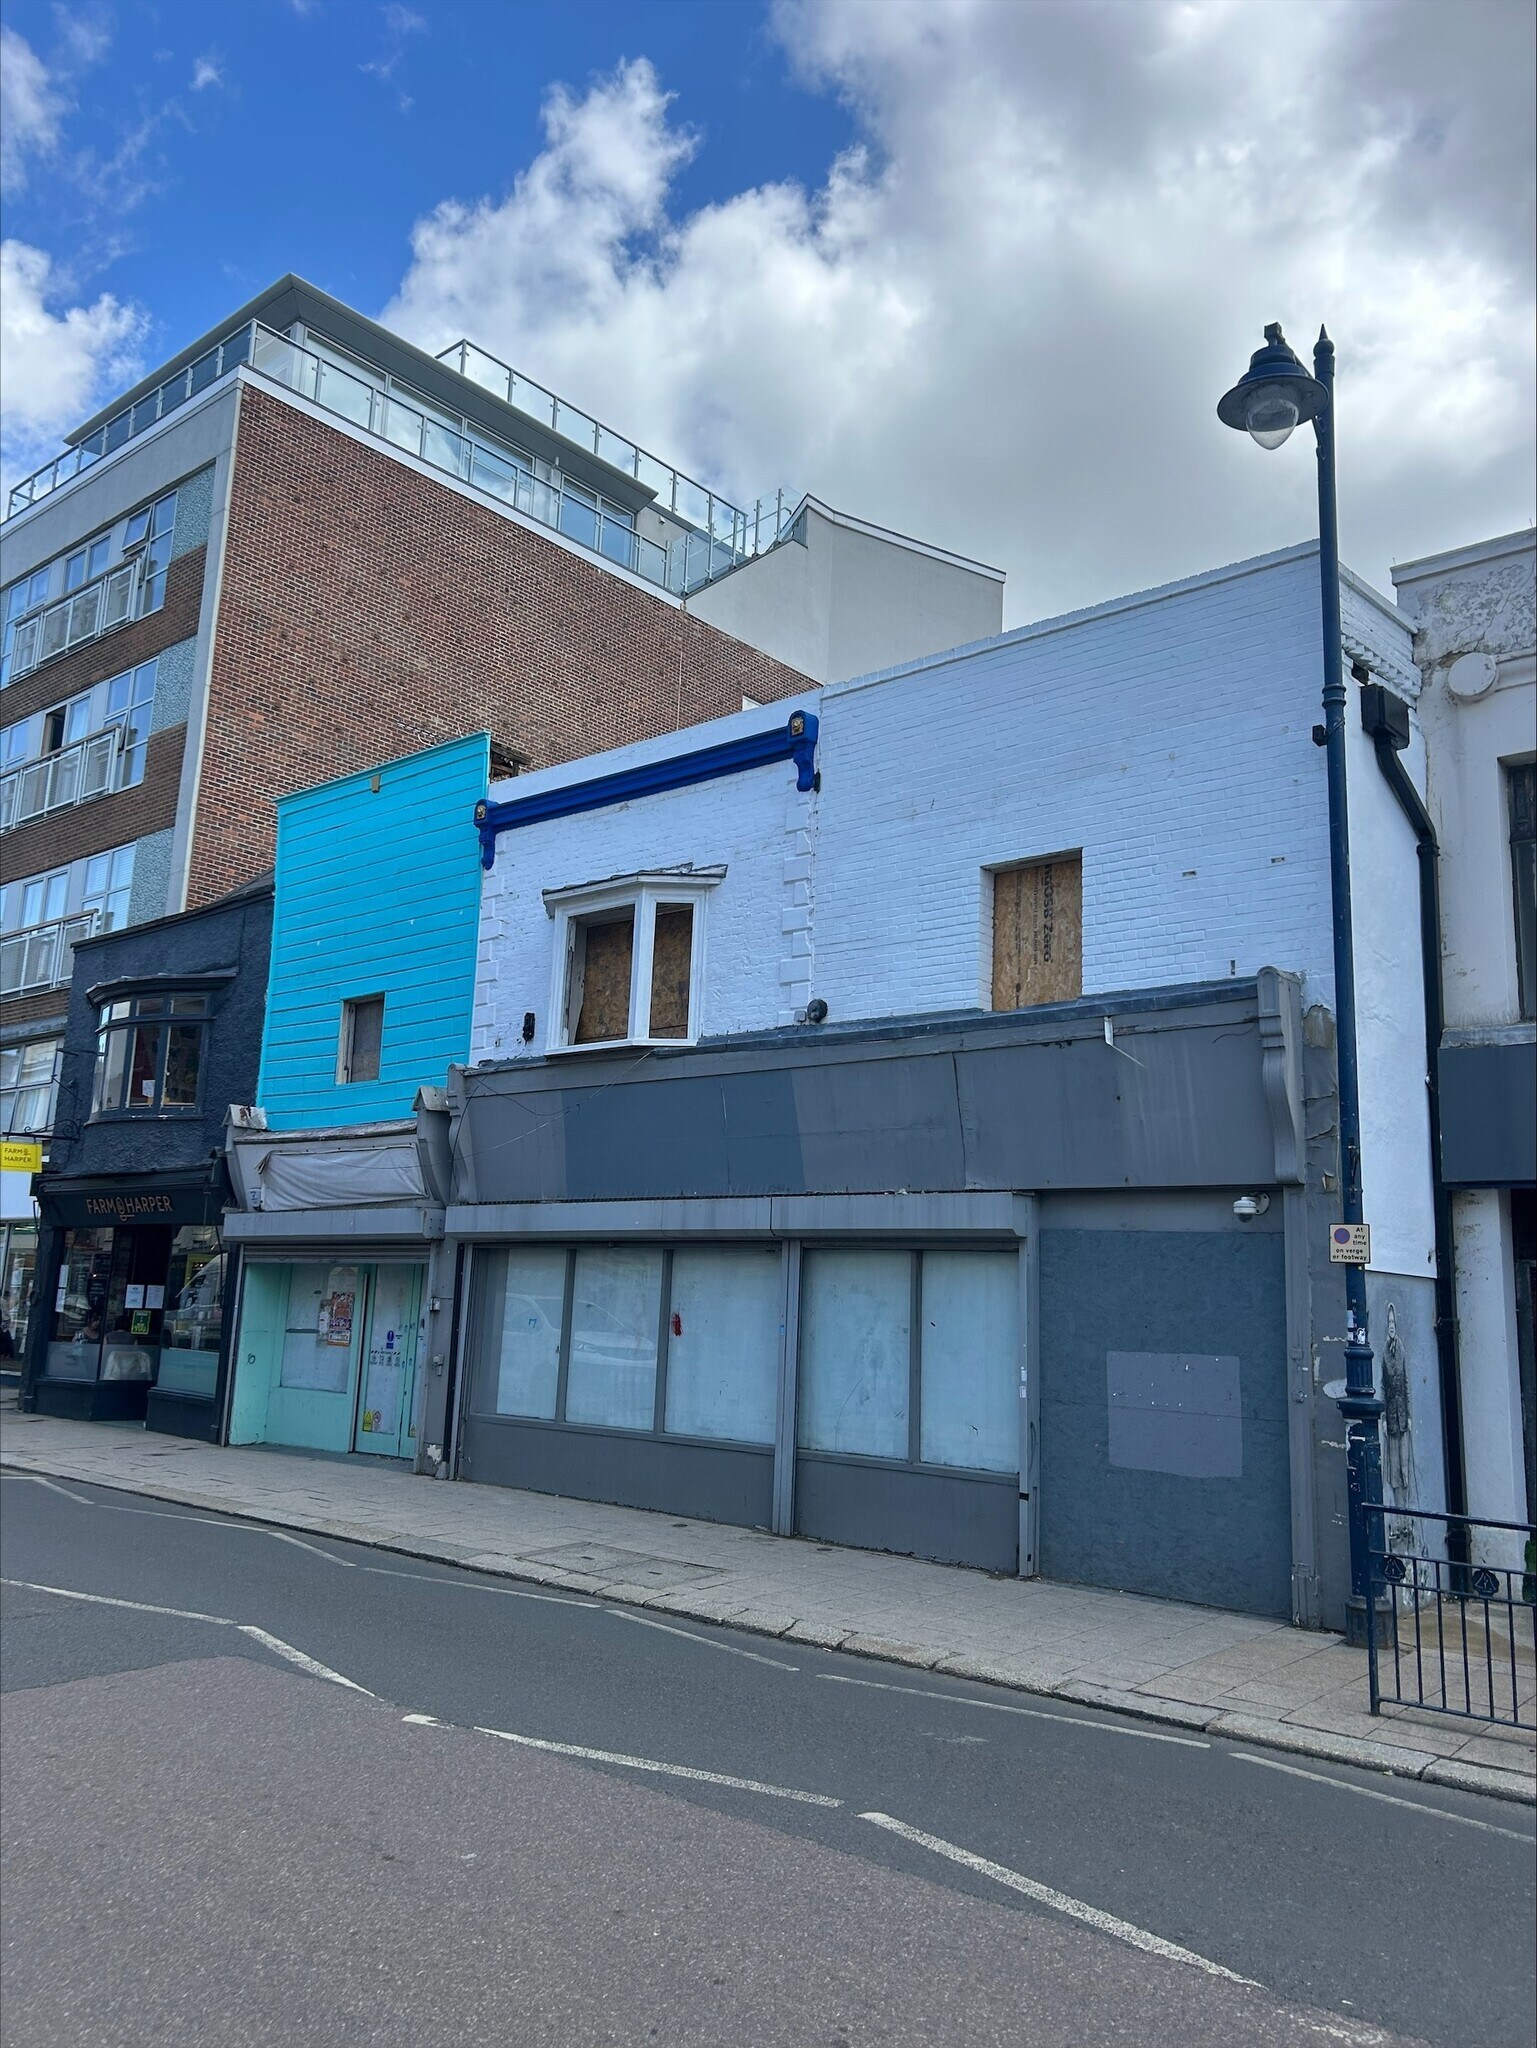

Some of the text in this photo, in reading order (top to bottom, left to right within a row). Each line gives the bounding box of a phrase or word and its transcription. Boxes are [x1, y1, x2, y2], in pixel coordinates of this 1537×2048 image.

[4, 1155, 32, 1163] HARPER
[86, 1198, 117, 1214] FARM
[124, 1195, 173, 1213] HARPER
